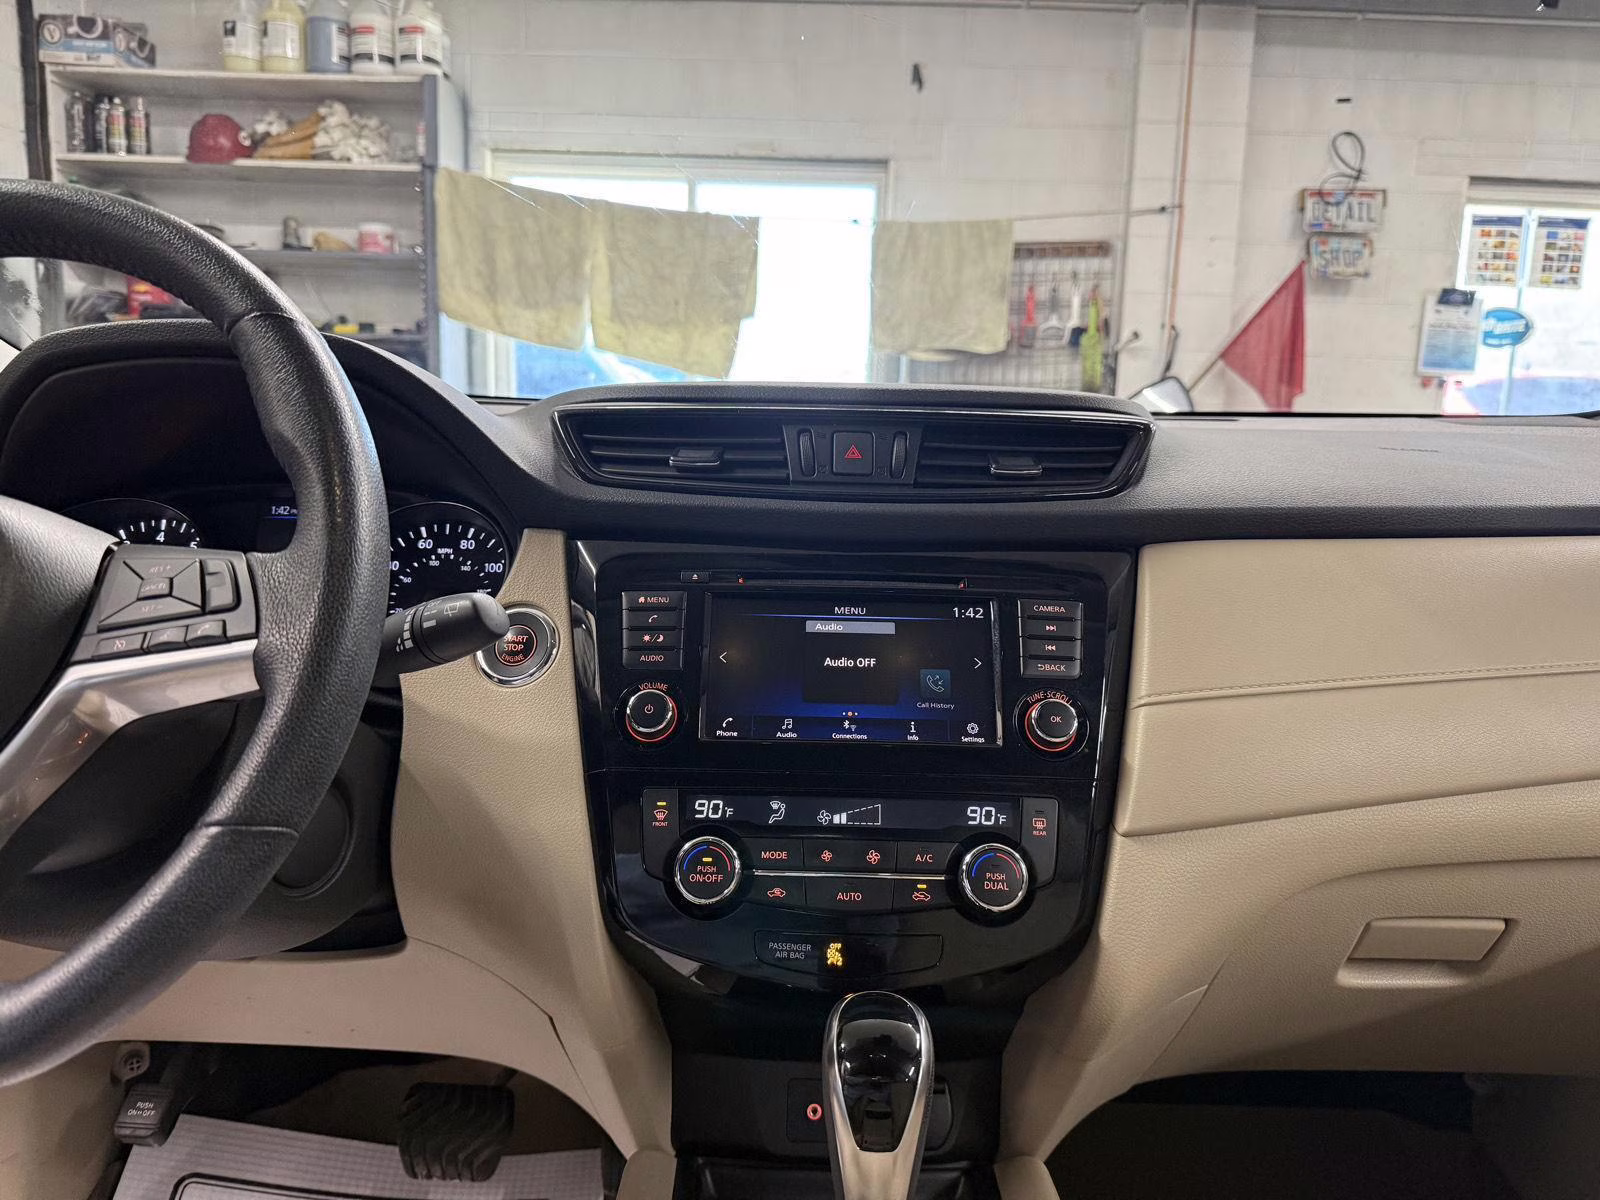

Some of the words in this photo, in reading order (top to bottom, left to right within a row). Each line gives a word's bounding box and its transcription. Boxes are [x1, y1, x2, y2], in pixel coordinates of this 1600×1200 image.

[1312, 200, 1377, 223] DETAIL
[1319, 249, 1364, 267] SHOP
[271, 505, 290, 515] 1:42
[155, 531, 166, 542] 4
[417, 538, 434, 549] 60
[459, 539, 476, 550] 80
[484, 562, 503, 573] 100
[646, 596, 670, 604] MENU
[834, 606, 866, 615] MENU
[952, 607, 984, 619] 1:42
[1033, 605, 1066, 613] CAMERA
[815, 623, 843, 631] Audio
[503, 635, 529, 643] START
[503, 643, 524, 651] STOP
[500, 652, 525, 662] ENGINE
[823, 657, 854, 667] Audio
[856, 658, 877, 668] OFF
[1045, 664, 1066, 672] BACK
[638, 682, 669, 692] VOLUME
[930, 702, 955, 710] History
[832, 732, 868, 740] Connections
[961, 735, 985, 743] Settings
[761, 851, 788, 860] MODE
[915, 854, 933, 862] A/C
[696, 865, 717, 873] PUSH
[689, 873, 724, 883] ON-OFF
[985, 872, 1006, 881] PUSH
[984, 881, 1009, 891] DUAL
[836, 892, 862, 901] AUTO
[768, 942, 812, 952] PASSENGER
[774, 951, 788, 959] AIR
[789, 951, 805, 960] BAG
[135, 1101, 154, 1109] PUSH
